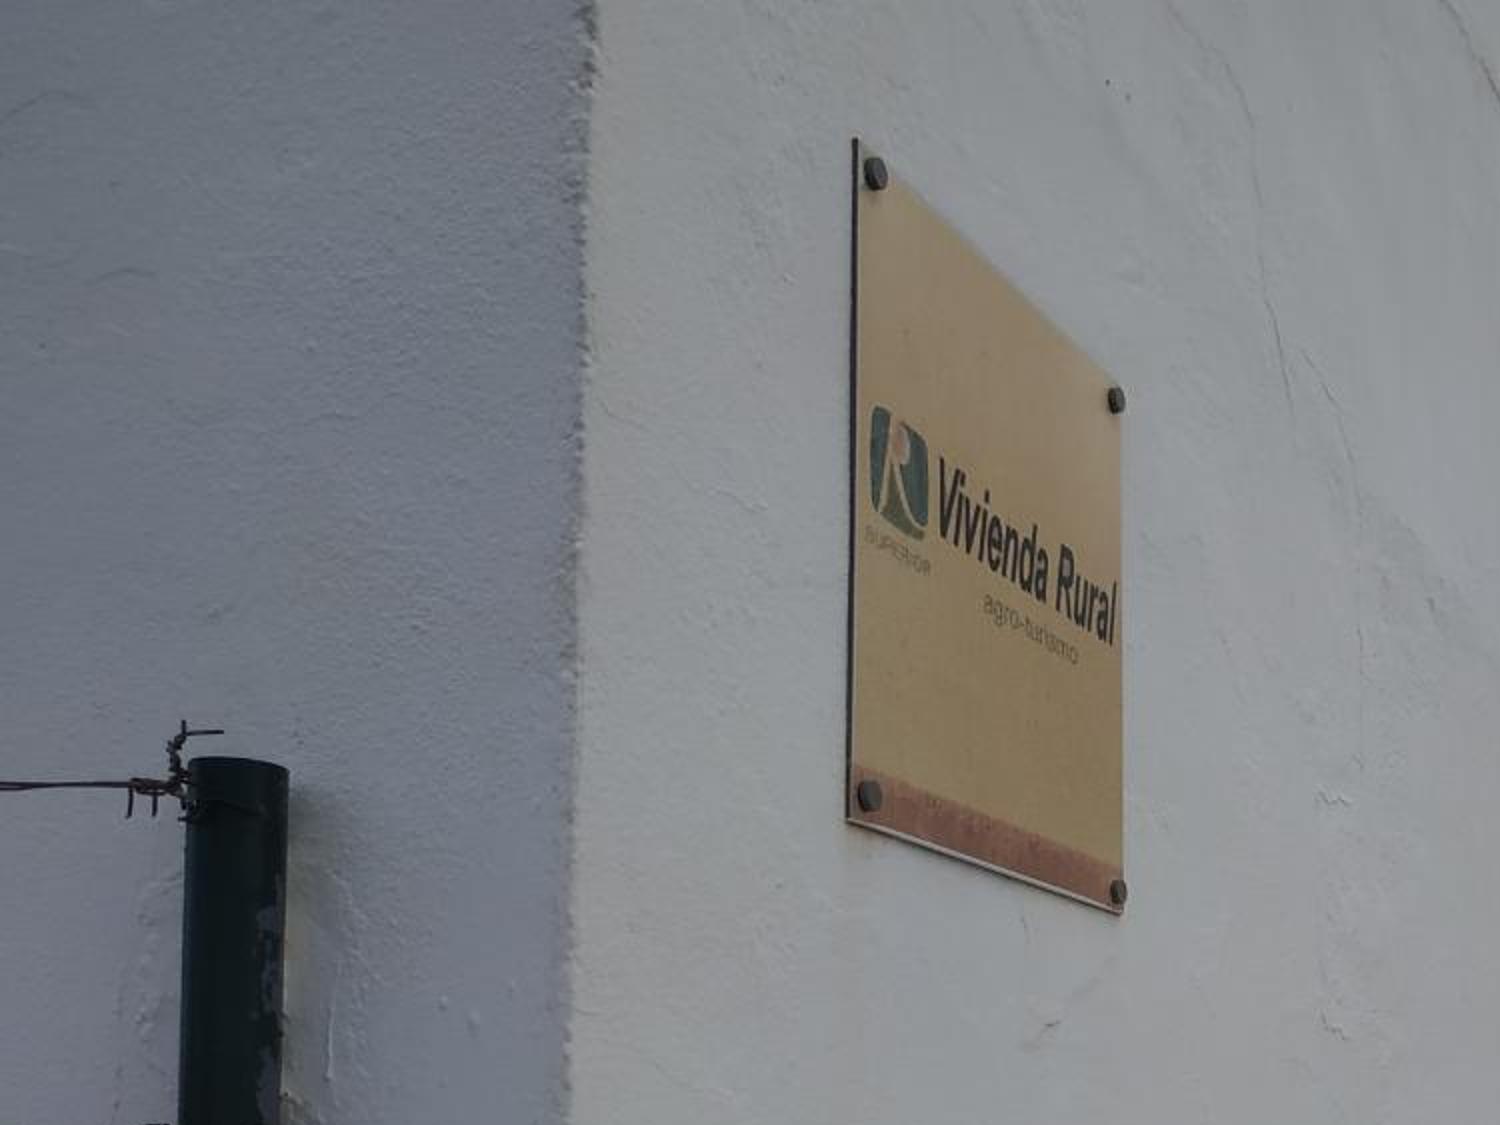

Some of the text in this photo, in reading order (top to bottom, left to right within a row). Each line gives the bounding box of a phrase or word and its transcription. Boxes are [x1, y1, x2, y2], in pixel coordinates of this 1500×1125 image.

[939, 456, 1118, 646] Vivienda Rural
[983, 594, 1080, 665] agro-turismo
